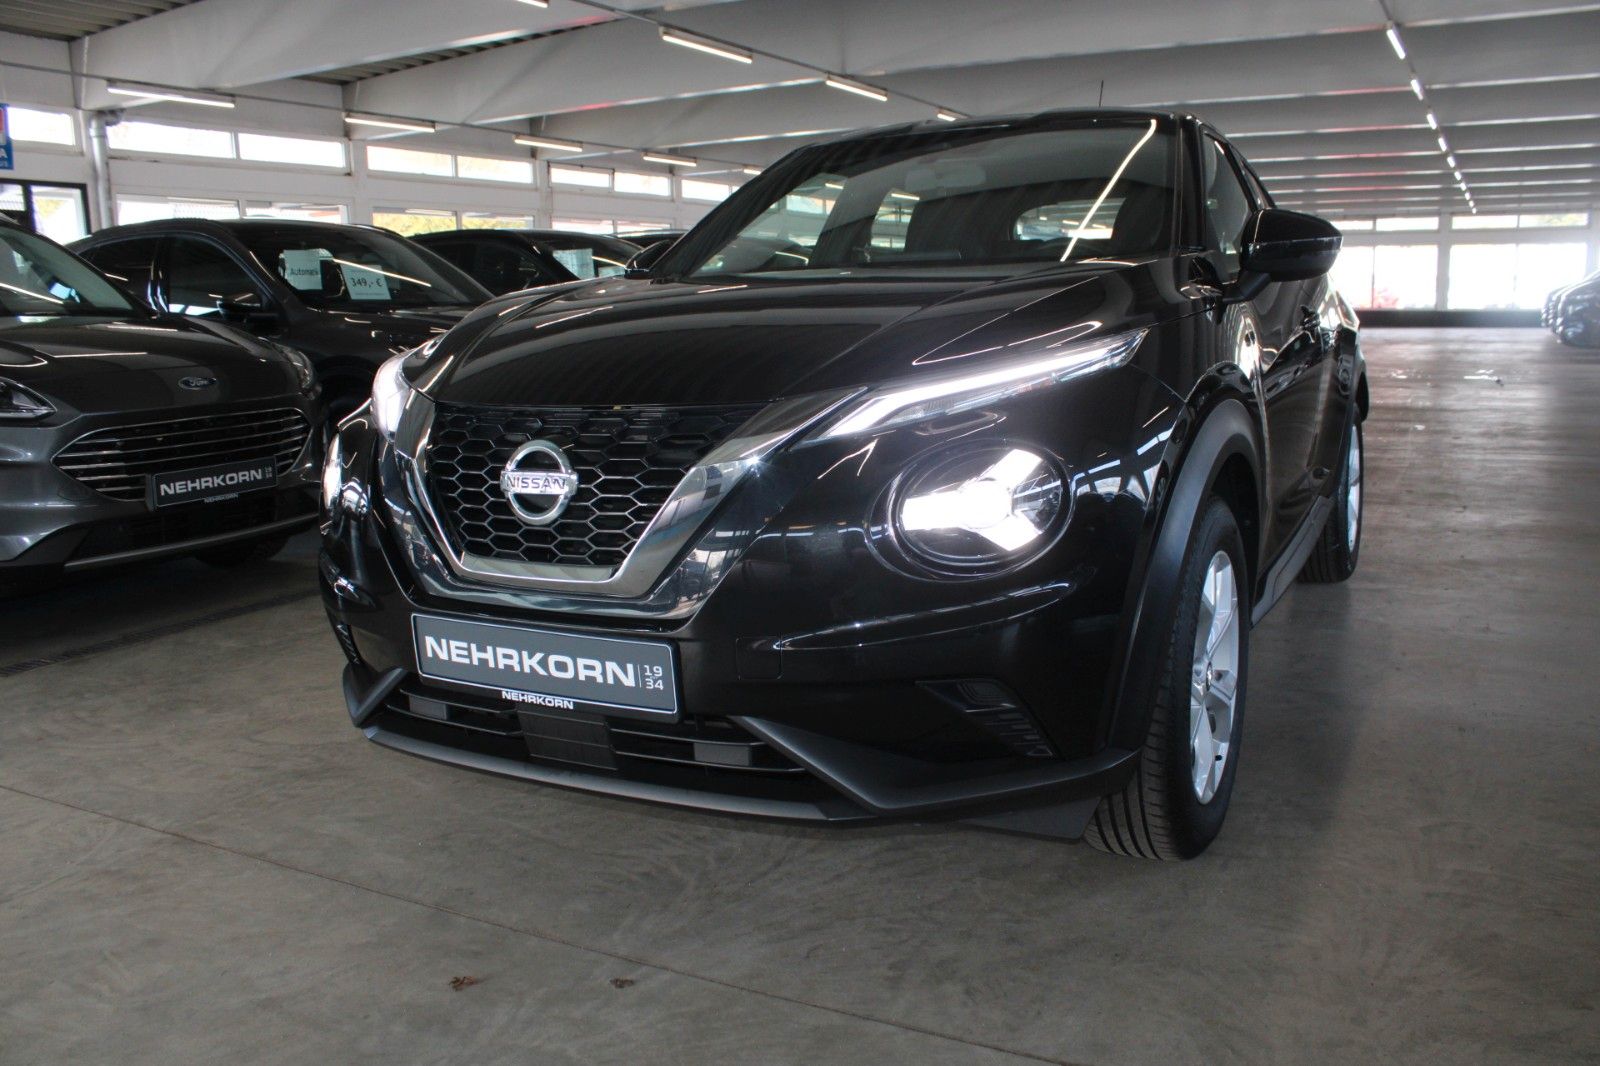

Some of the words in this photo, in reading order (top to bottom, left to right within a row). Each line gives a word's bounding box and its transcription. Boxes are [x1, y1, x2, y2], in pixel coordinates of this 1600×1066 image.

[376, 278, 383, 287] €
[160, 469, 262, 496] NEHRKORN
[506, 476, 566, 490] NISSAN
[424, 636, 636, 687] NEHRKORN
[644, 665, 663, 677] 19
[645, 678, 664, 690] 34
[501, 690, 574, 710] NEHRKORN
